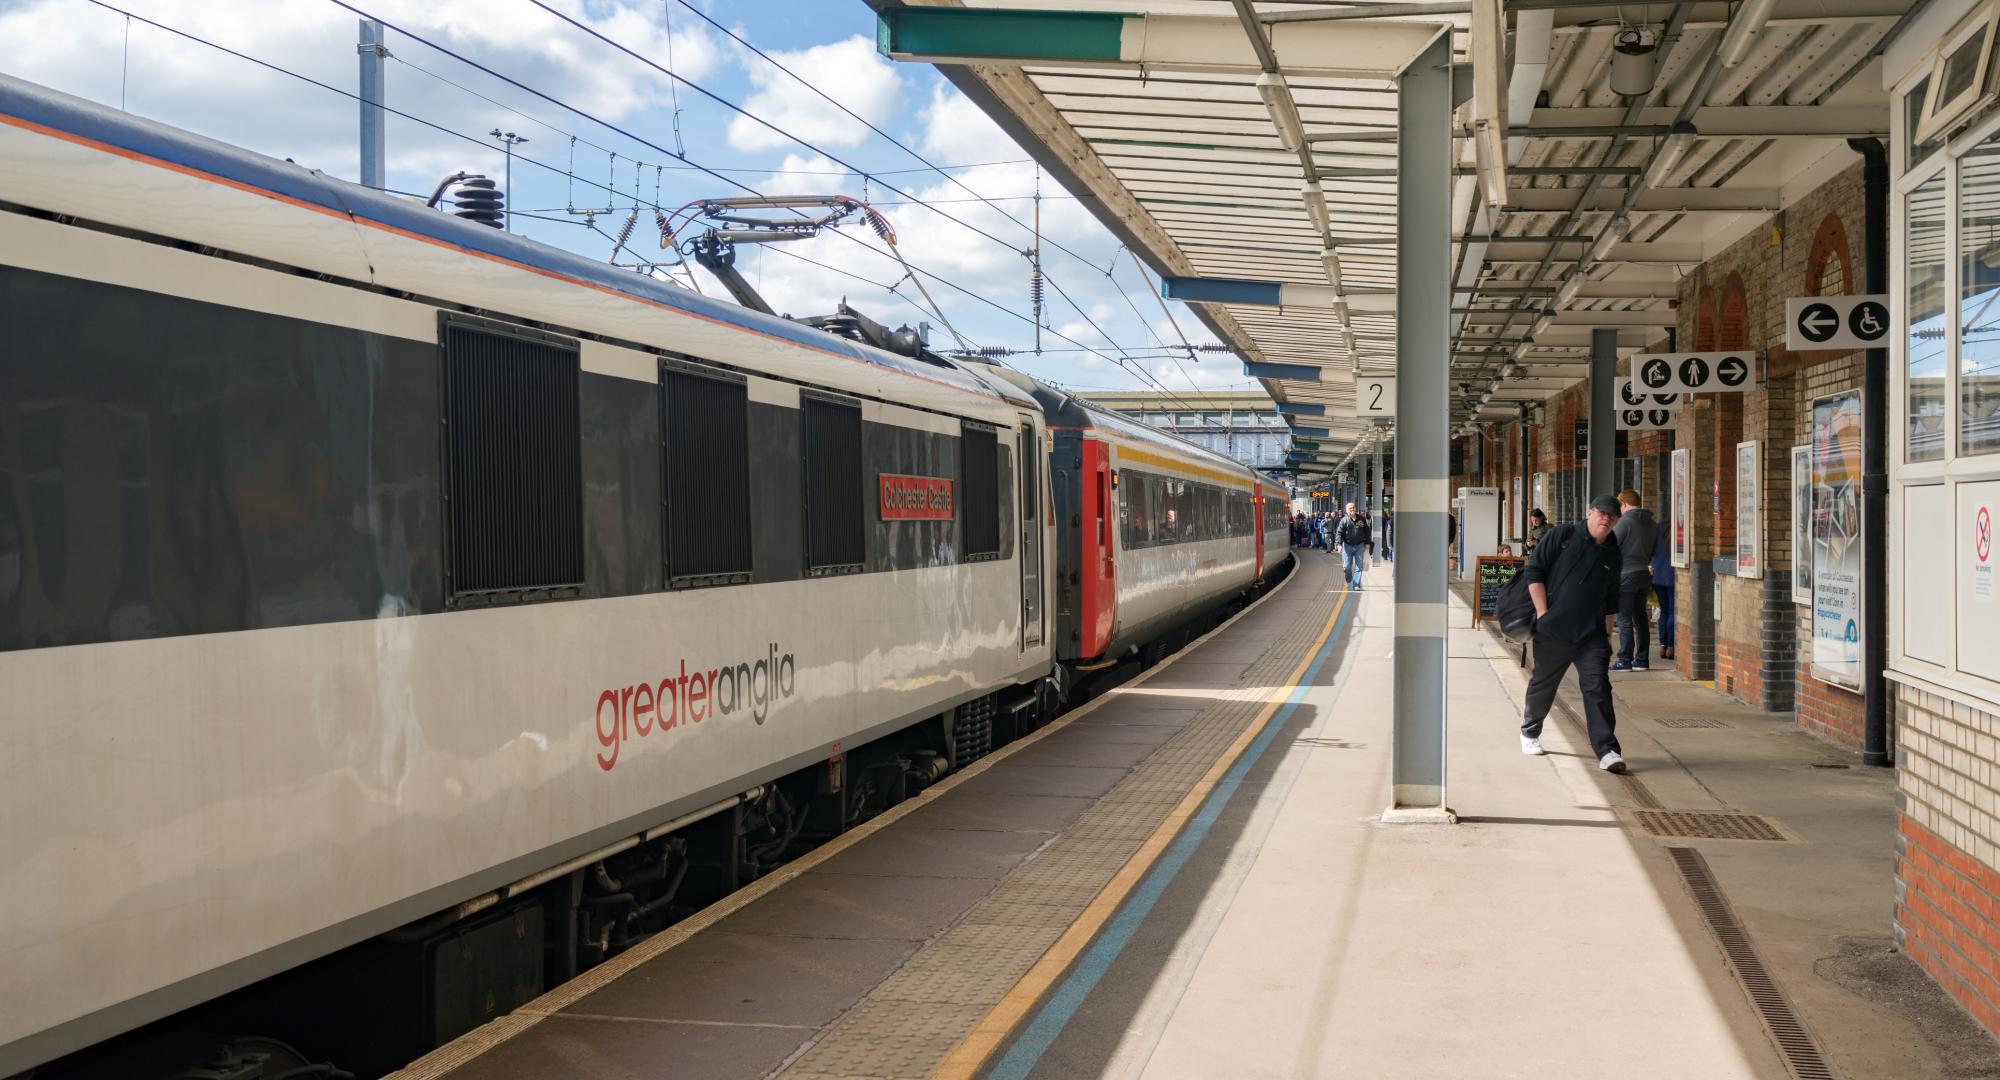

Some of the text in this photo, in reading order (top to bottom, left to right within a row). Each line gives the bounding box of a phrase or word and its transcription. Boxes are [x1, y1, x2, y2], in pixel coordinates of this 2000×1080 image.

[1369, 383, 1383, 410] 2
[884, 480, 951, 511] Colchester Castle
